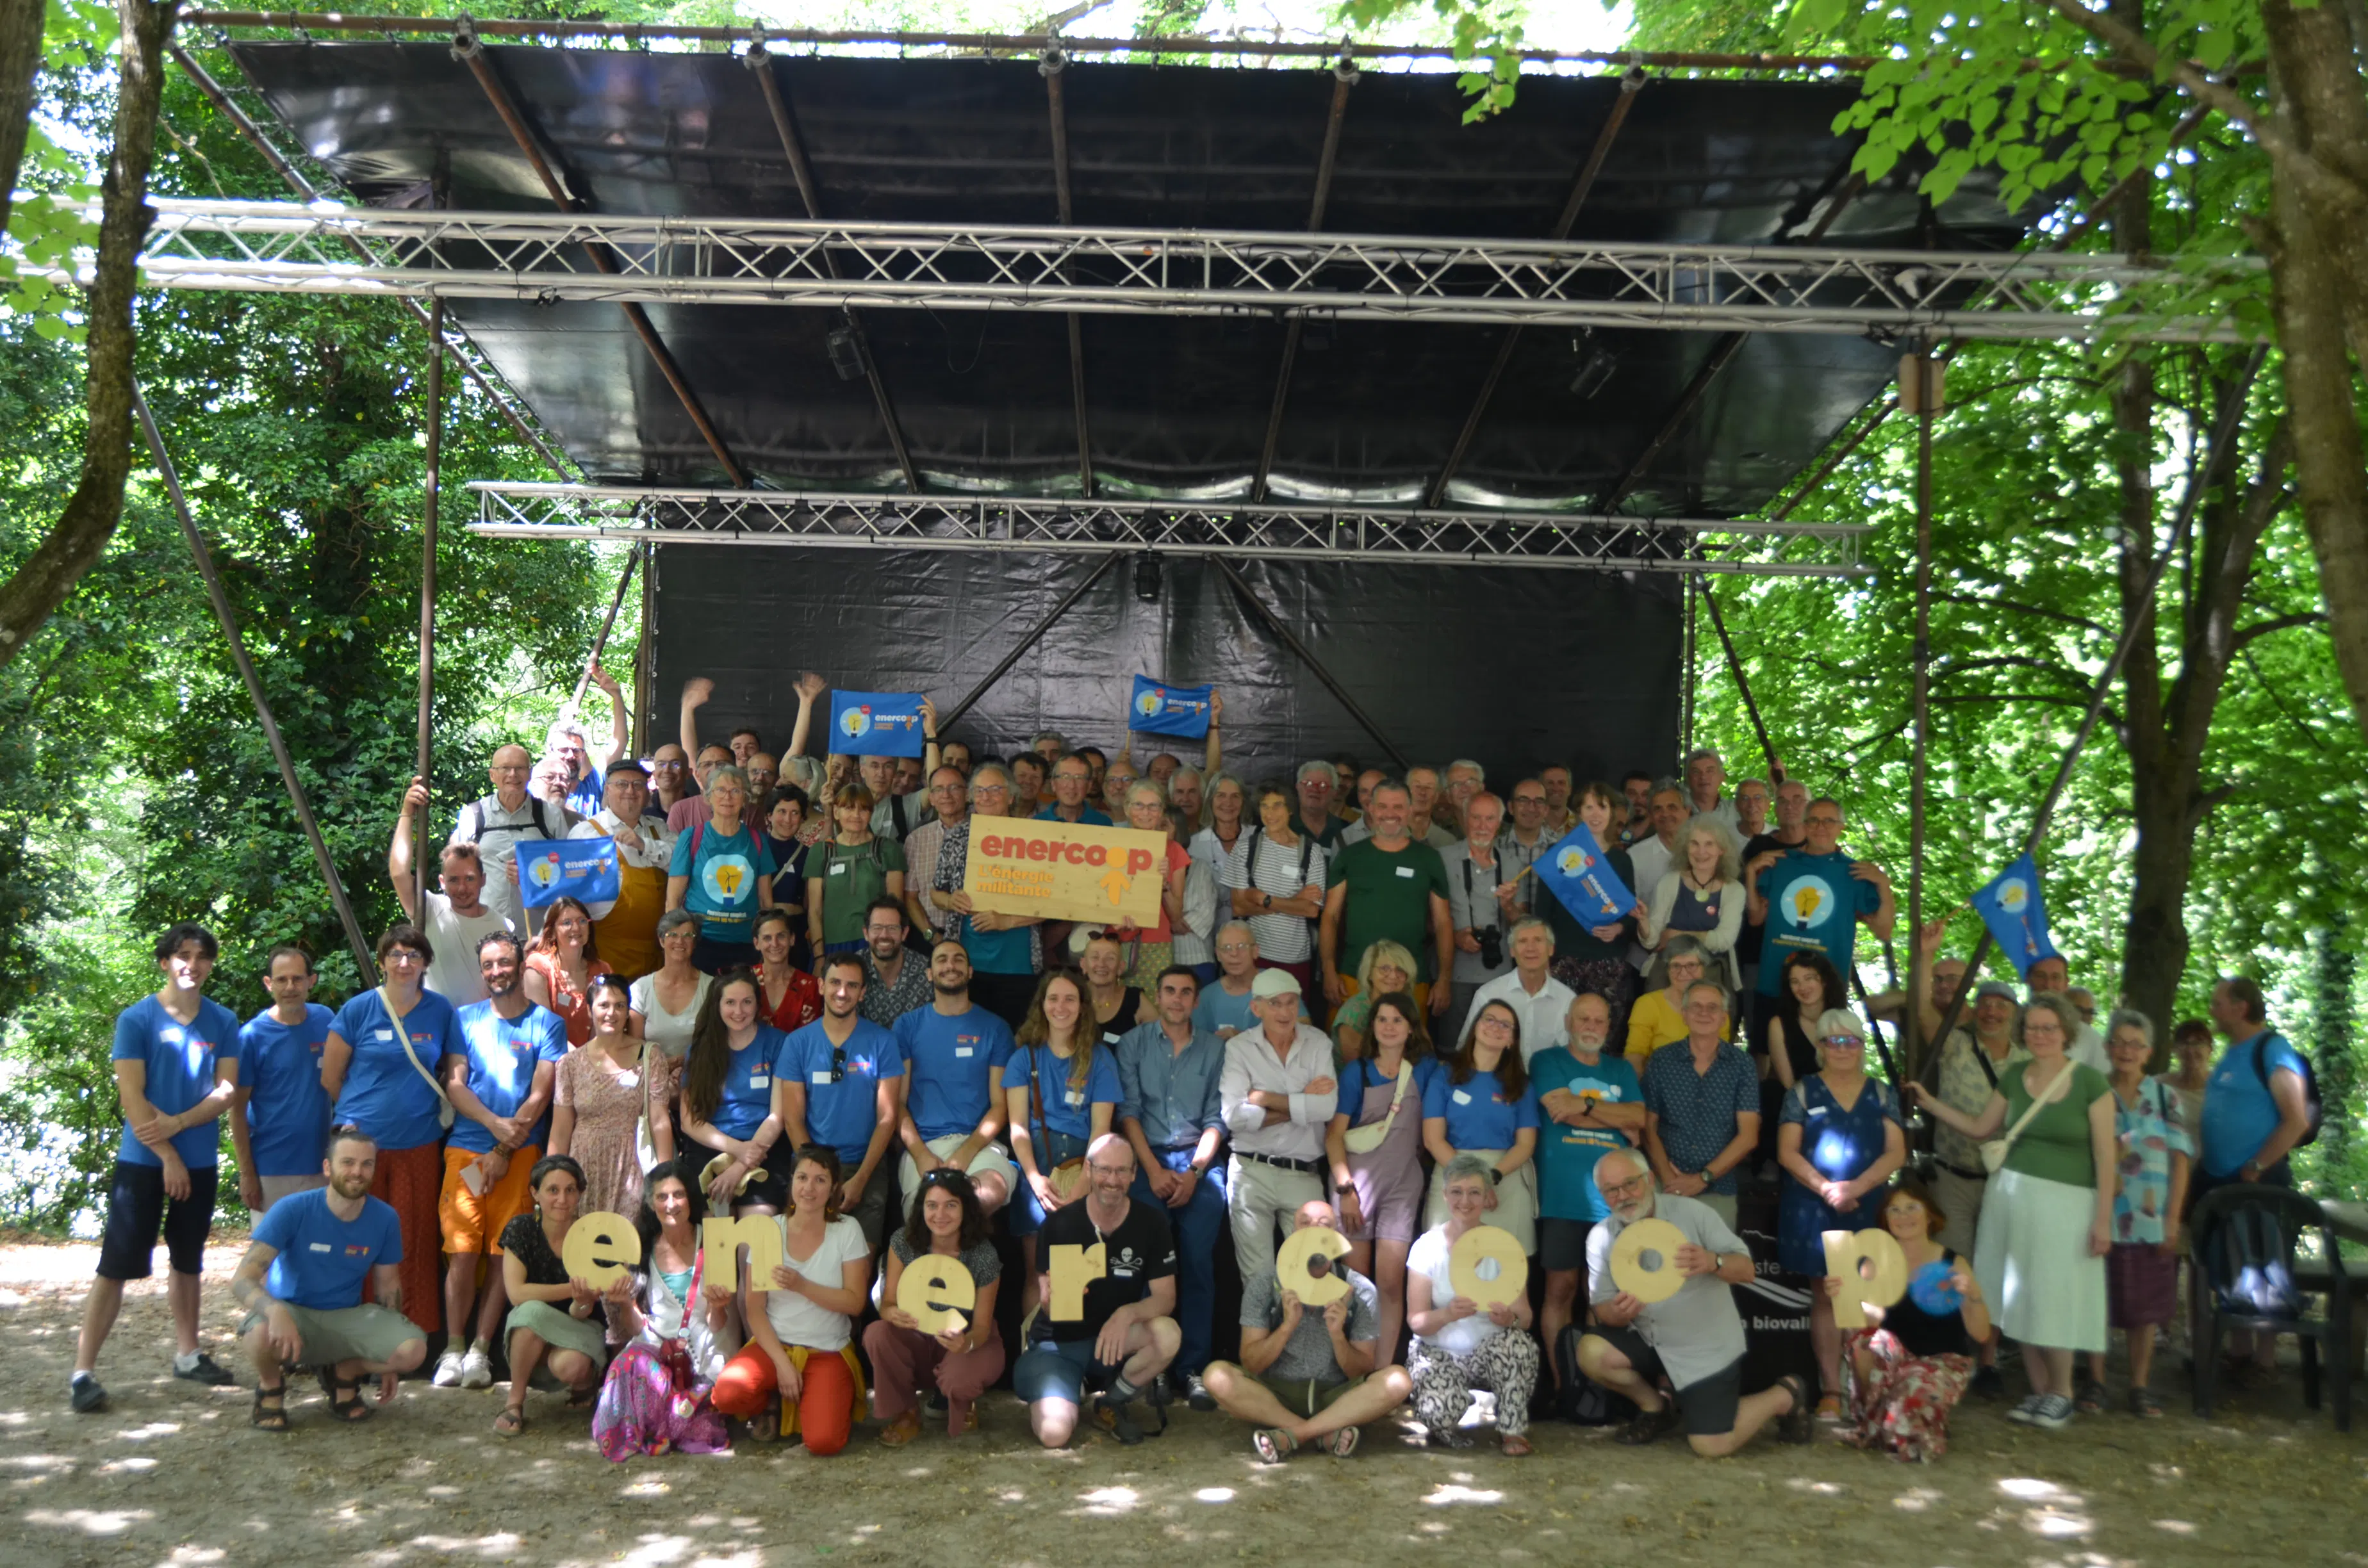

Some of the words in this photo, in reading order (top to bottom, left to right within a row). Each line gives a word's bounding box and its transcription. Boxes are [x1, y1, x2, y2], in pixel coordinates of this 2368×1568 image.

[978, 864, 1055, 883] L'énergie
[976, 881, 1051, 897] militante
[1753, 1315, 1810, 1330] biovall
